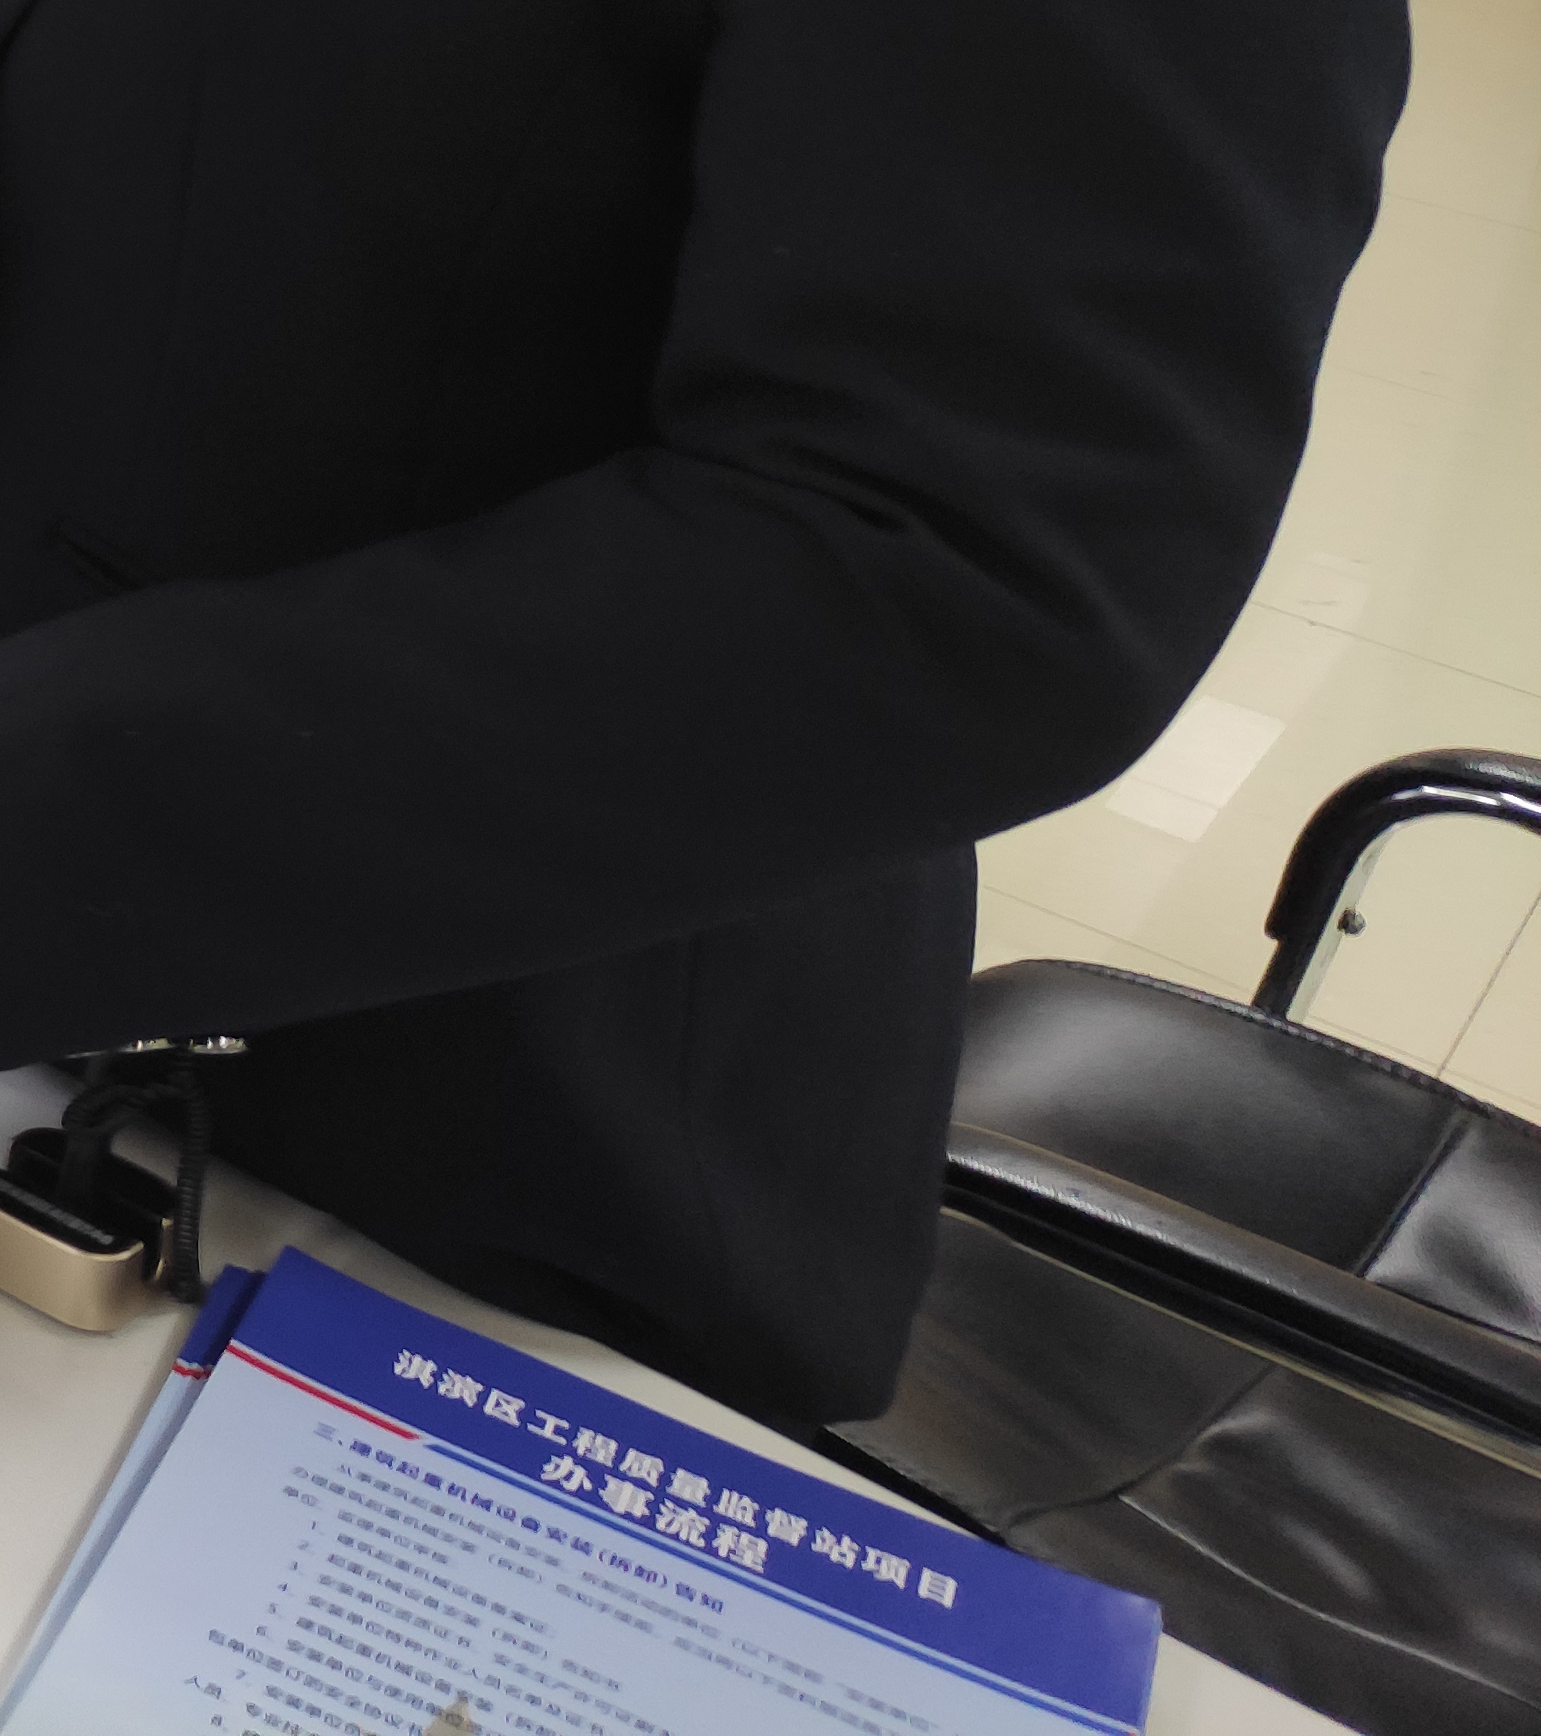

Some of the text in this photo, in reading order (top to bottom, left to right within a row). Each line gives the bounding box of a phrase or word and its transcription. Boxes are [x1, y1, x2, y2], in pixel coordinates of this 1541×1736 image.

[391, 1347, 958, 1610] 淇滨区工程质量监督站项目
[539, 1452, 769, 1575] 办事流程
